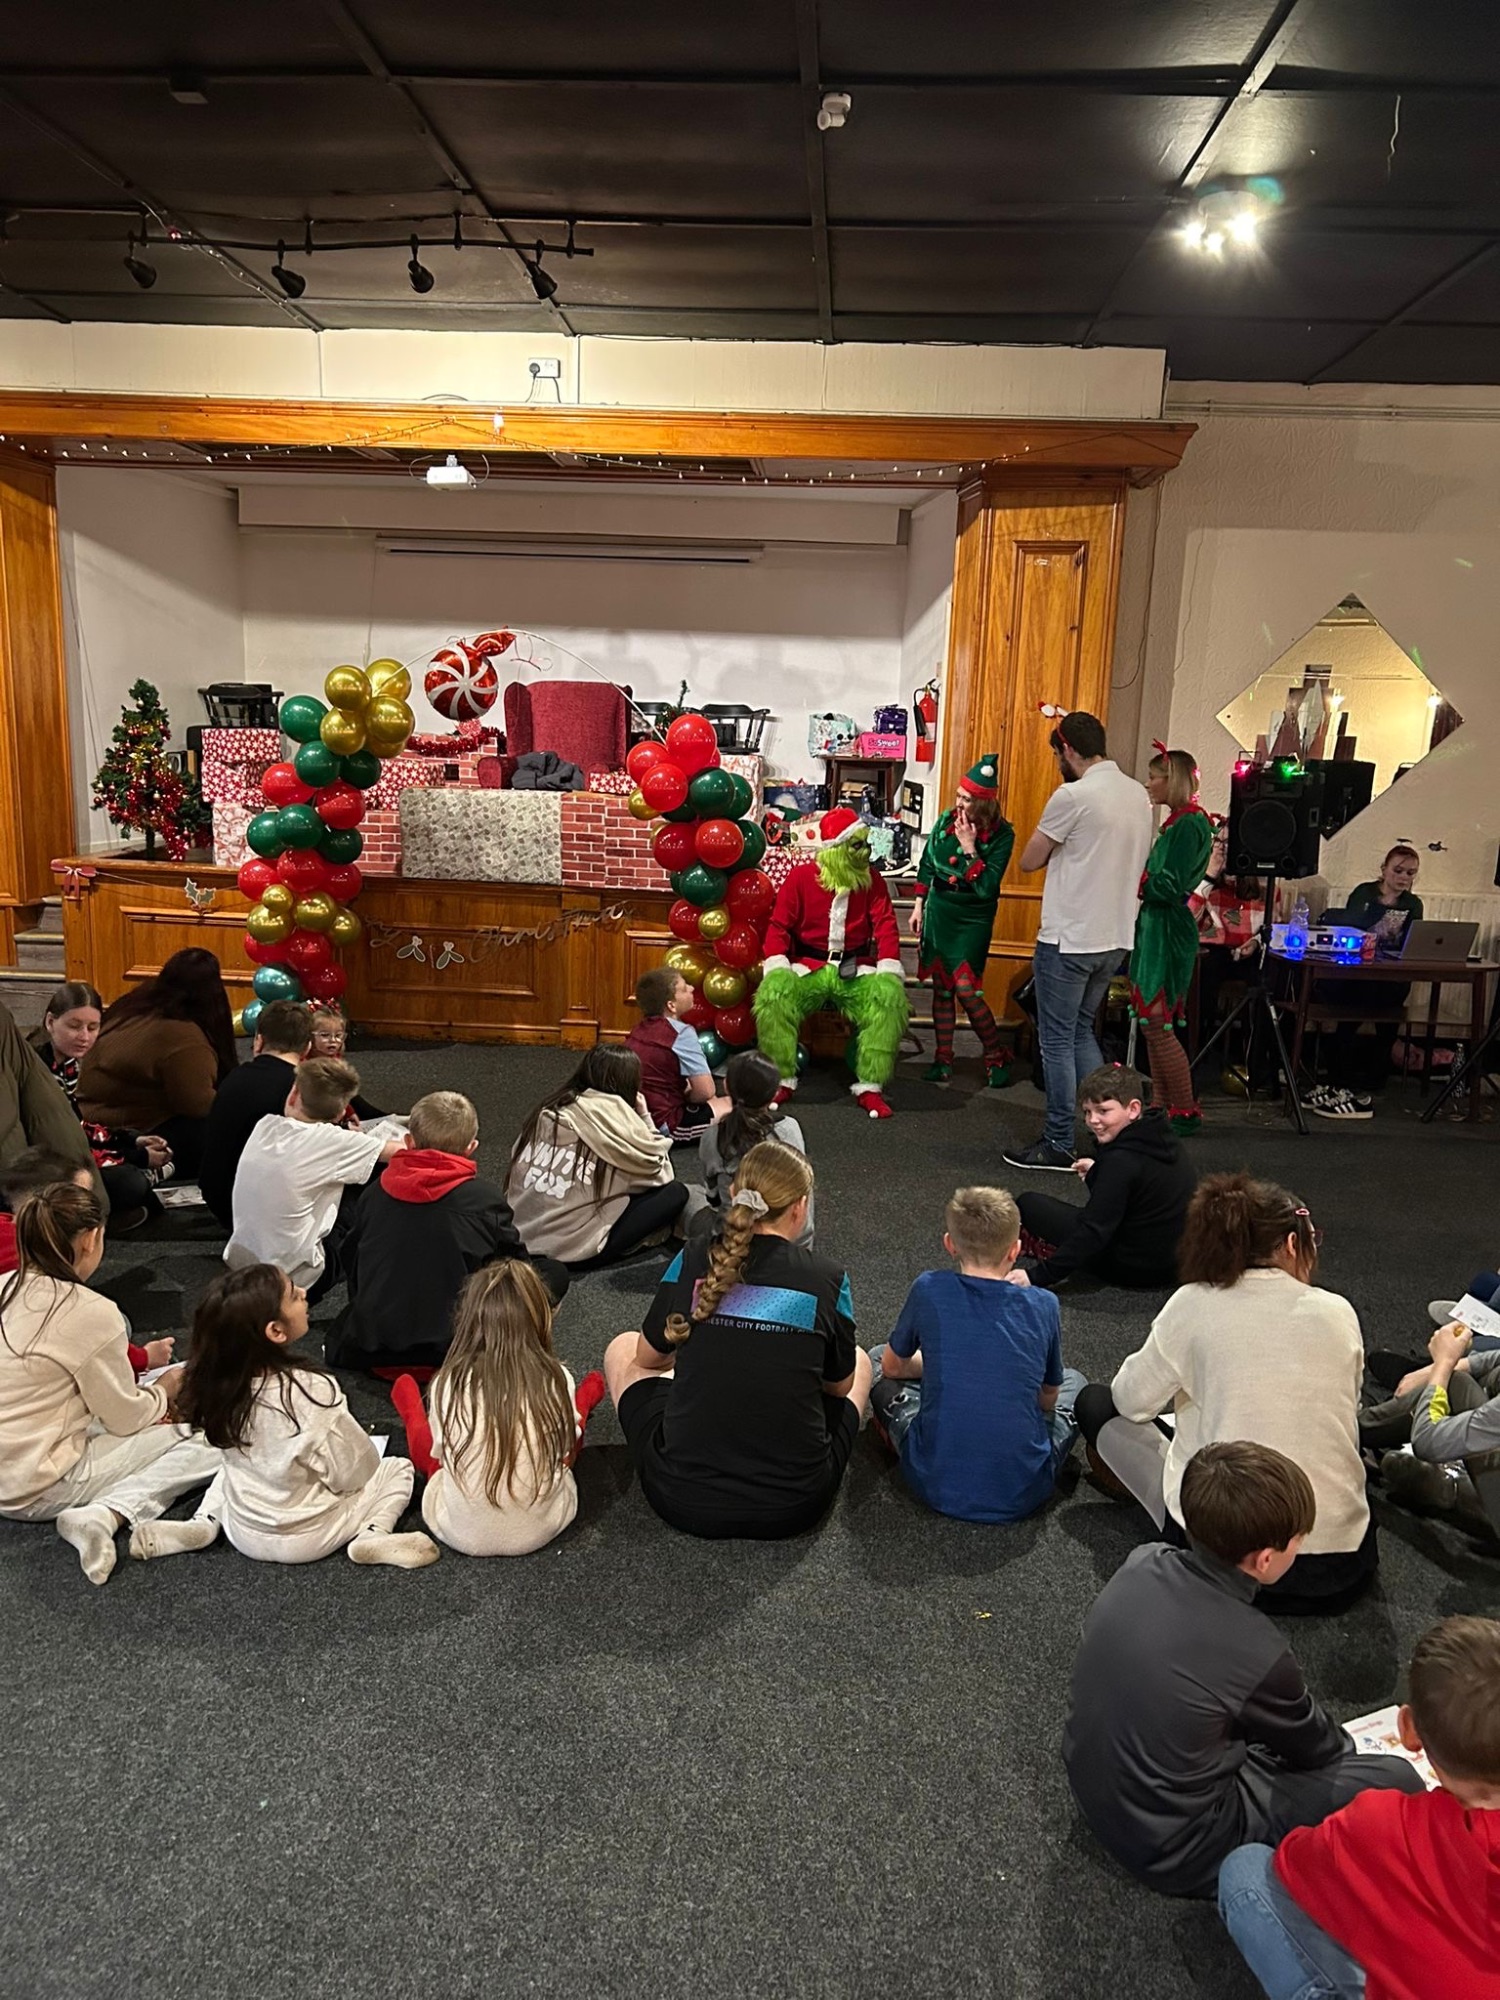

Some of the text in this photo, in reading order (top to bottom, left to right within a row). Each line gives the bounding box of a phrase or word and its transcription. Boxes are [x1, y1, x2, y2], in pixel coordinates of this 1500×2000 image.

[517, 1141, 597, 1186] WHITE
[523, 1166, 575, 1199] FOX
[736, 1321, 754, 1330] CITY
